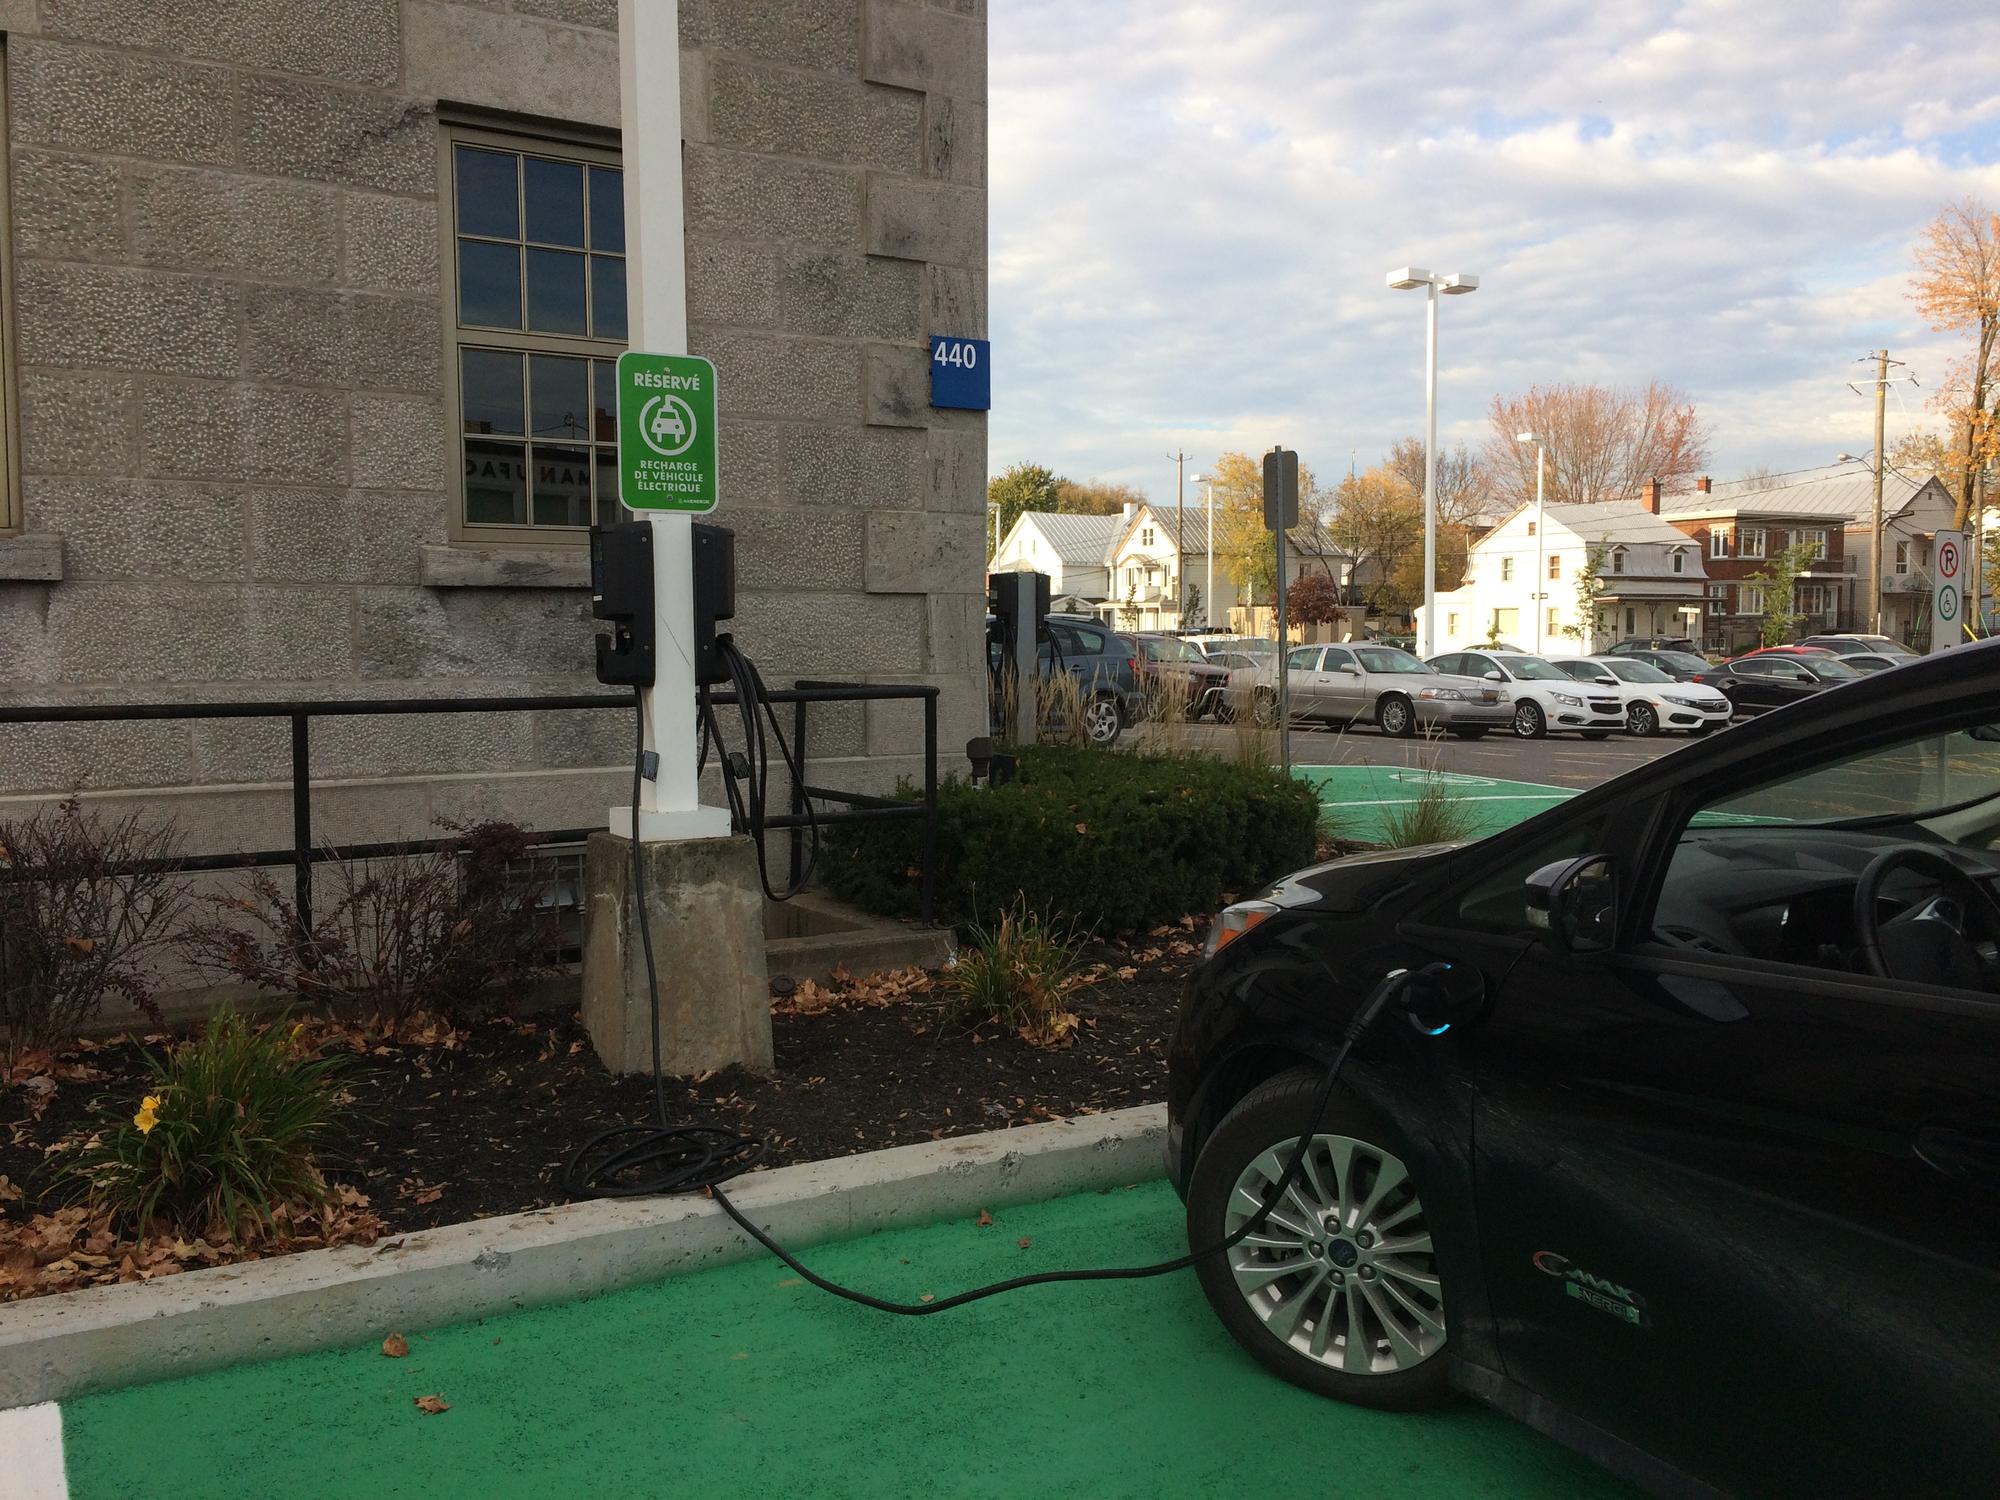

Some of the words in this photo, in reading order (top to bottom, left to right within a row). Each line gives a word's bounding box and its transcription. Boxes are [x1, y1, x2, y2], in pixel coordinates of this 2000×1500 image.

[934, 342, 977, 369] 440
[634, 370, 700, 391] RÉSERVÉ
[640, 460, 698, 471] RECHARGE
[634, 470, 648, 479] DE
[652, 470, 704, 482] VÉHICULE
[637, 481, 701, 493] ÉLECTRIQUE
